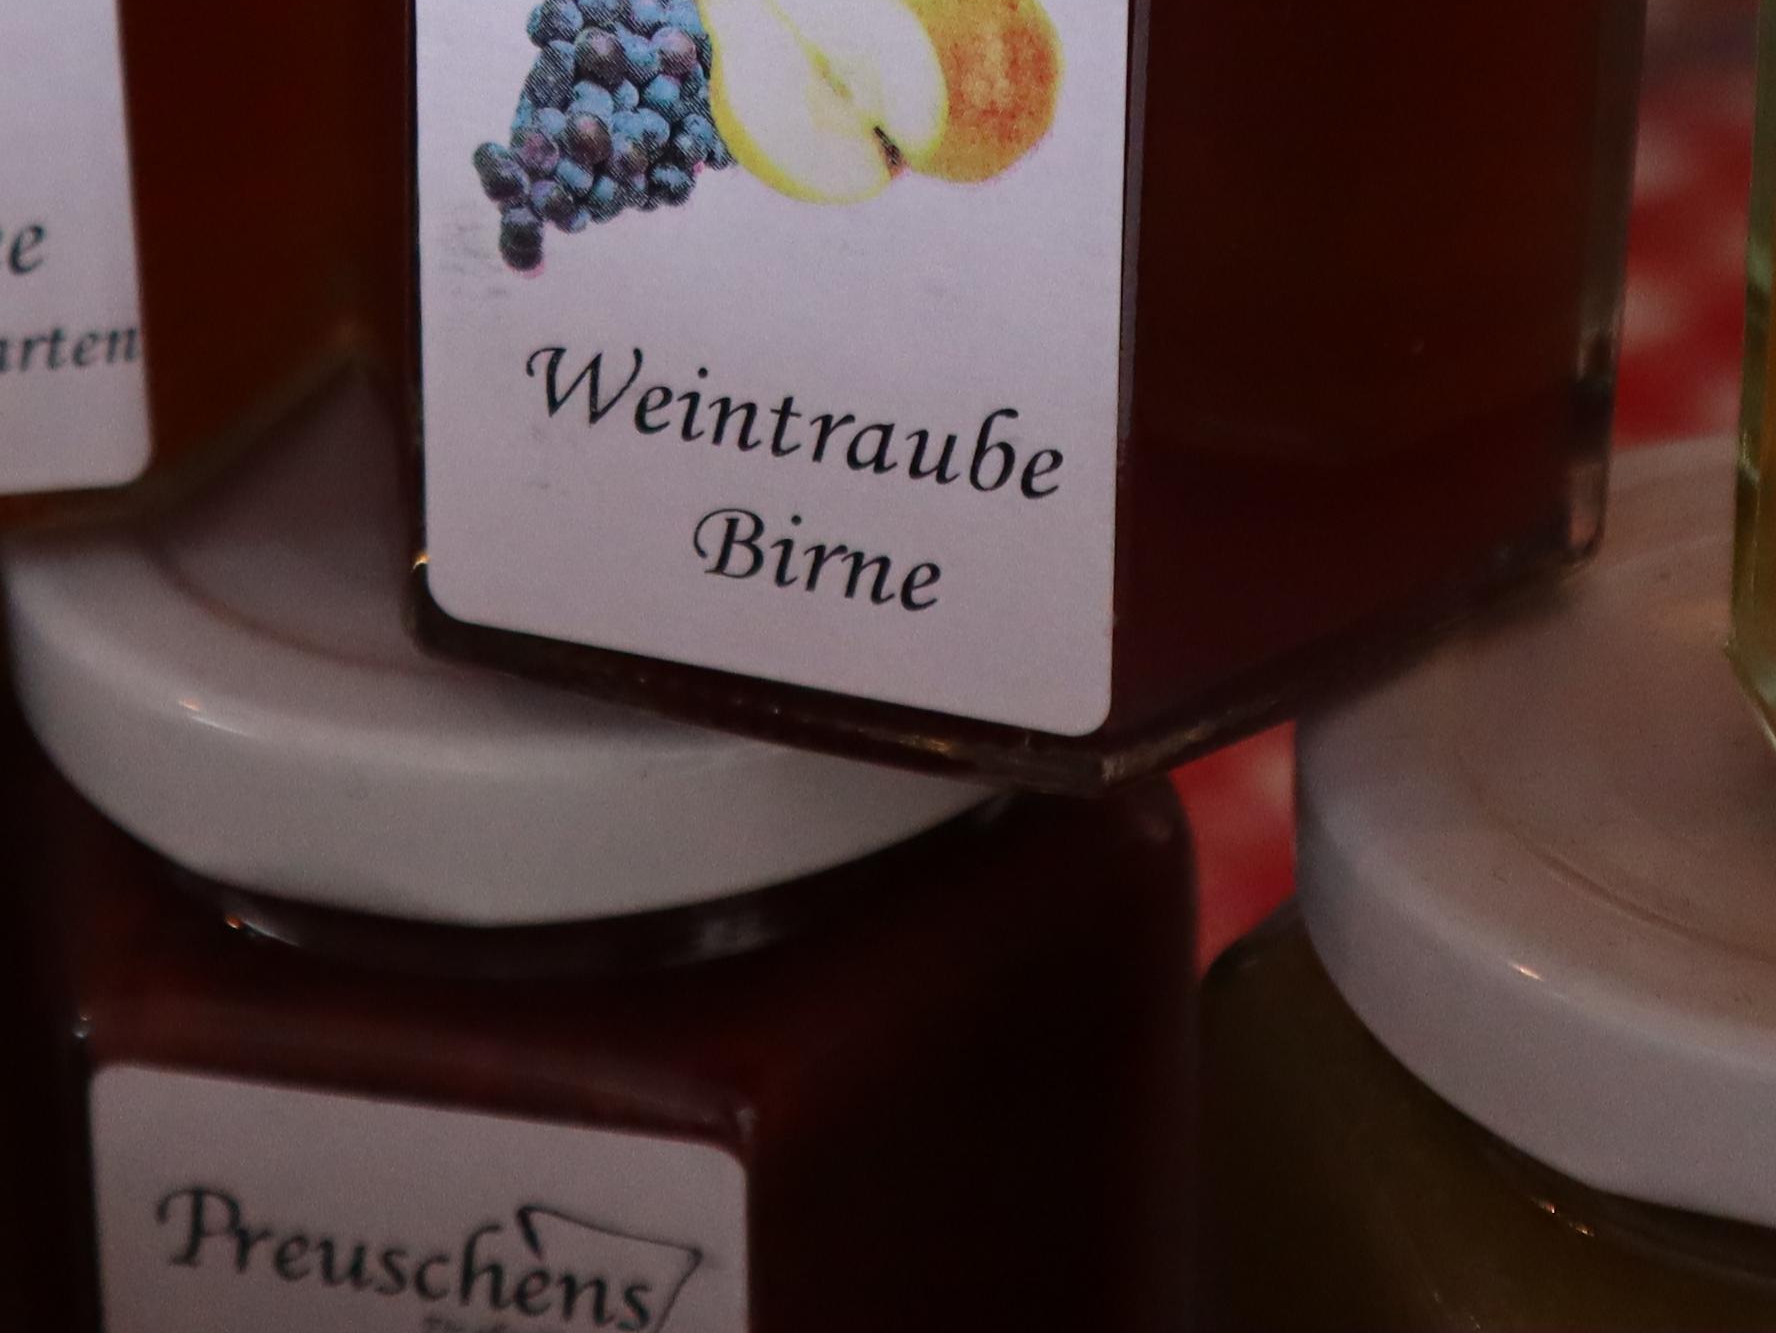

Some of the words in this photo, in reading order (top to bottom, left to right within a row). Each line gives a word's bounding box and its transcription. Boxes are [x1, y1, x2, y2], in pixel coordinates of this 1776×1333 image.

[525, 346, 1065, 500] Weintraube
[692, 507, 943, 612] Birne
[155, 1183, 654, 1332] Preuschens
